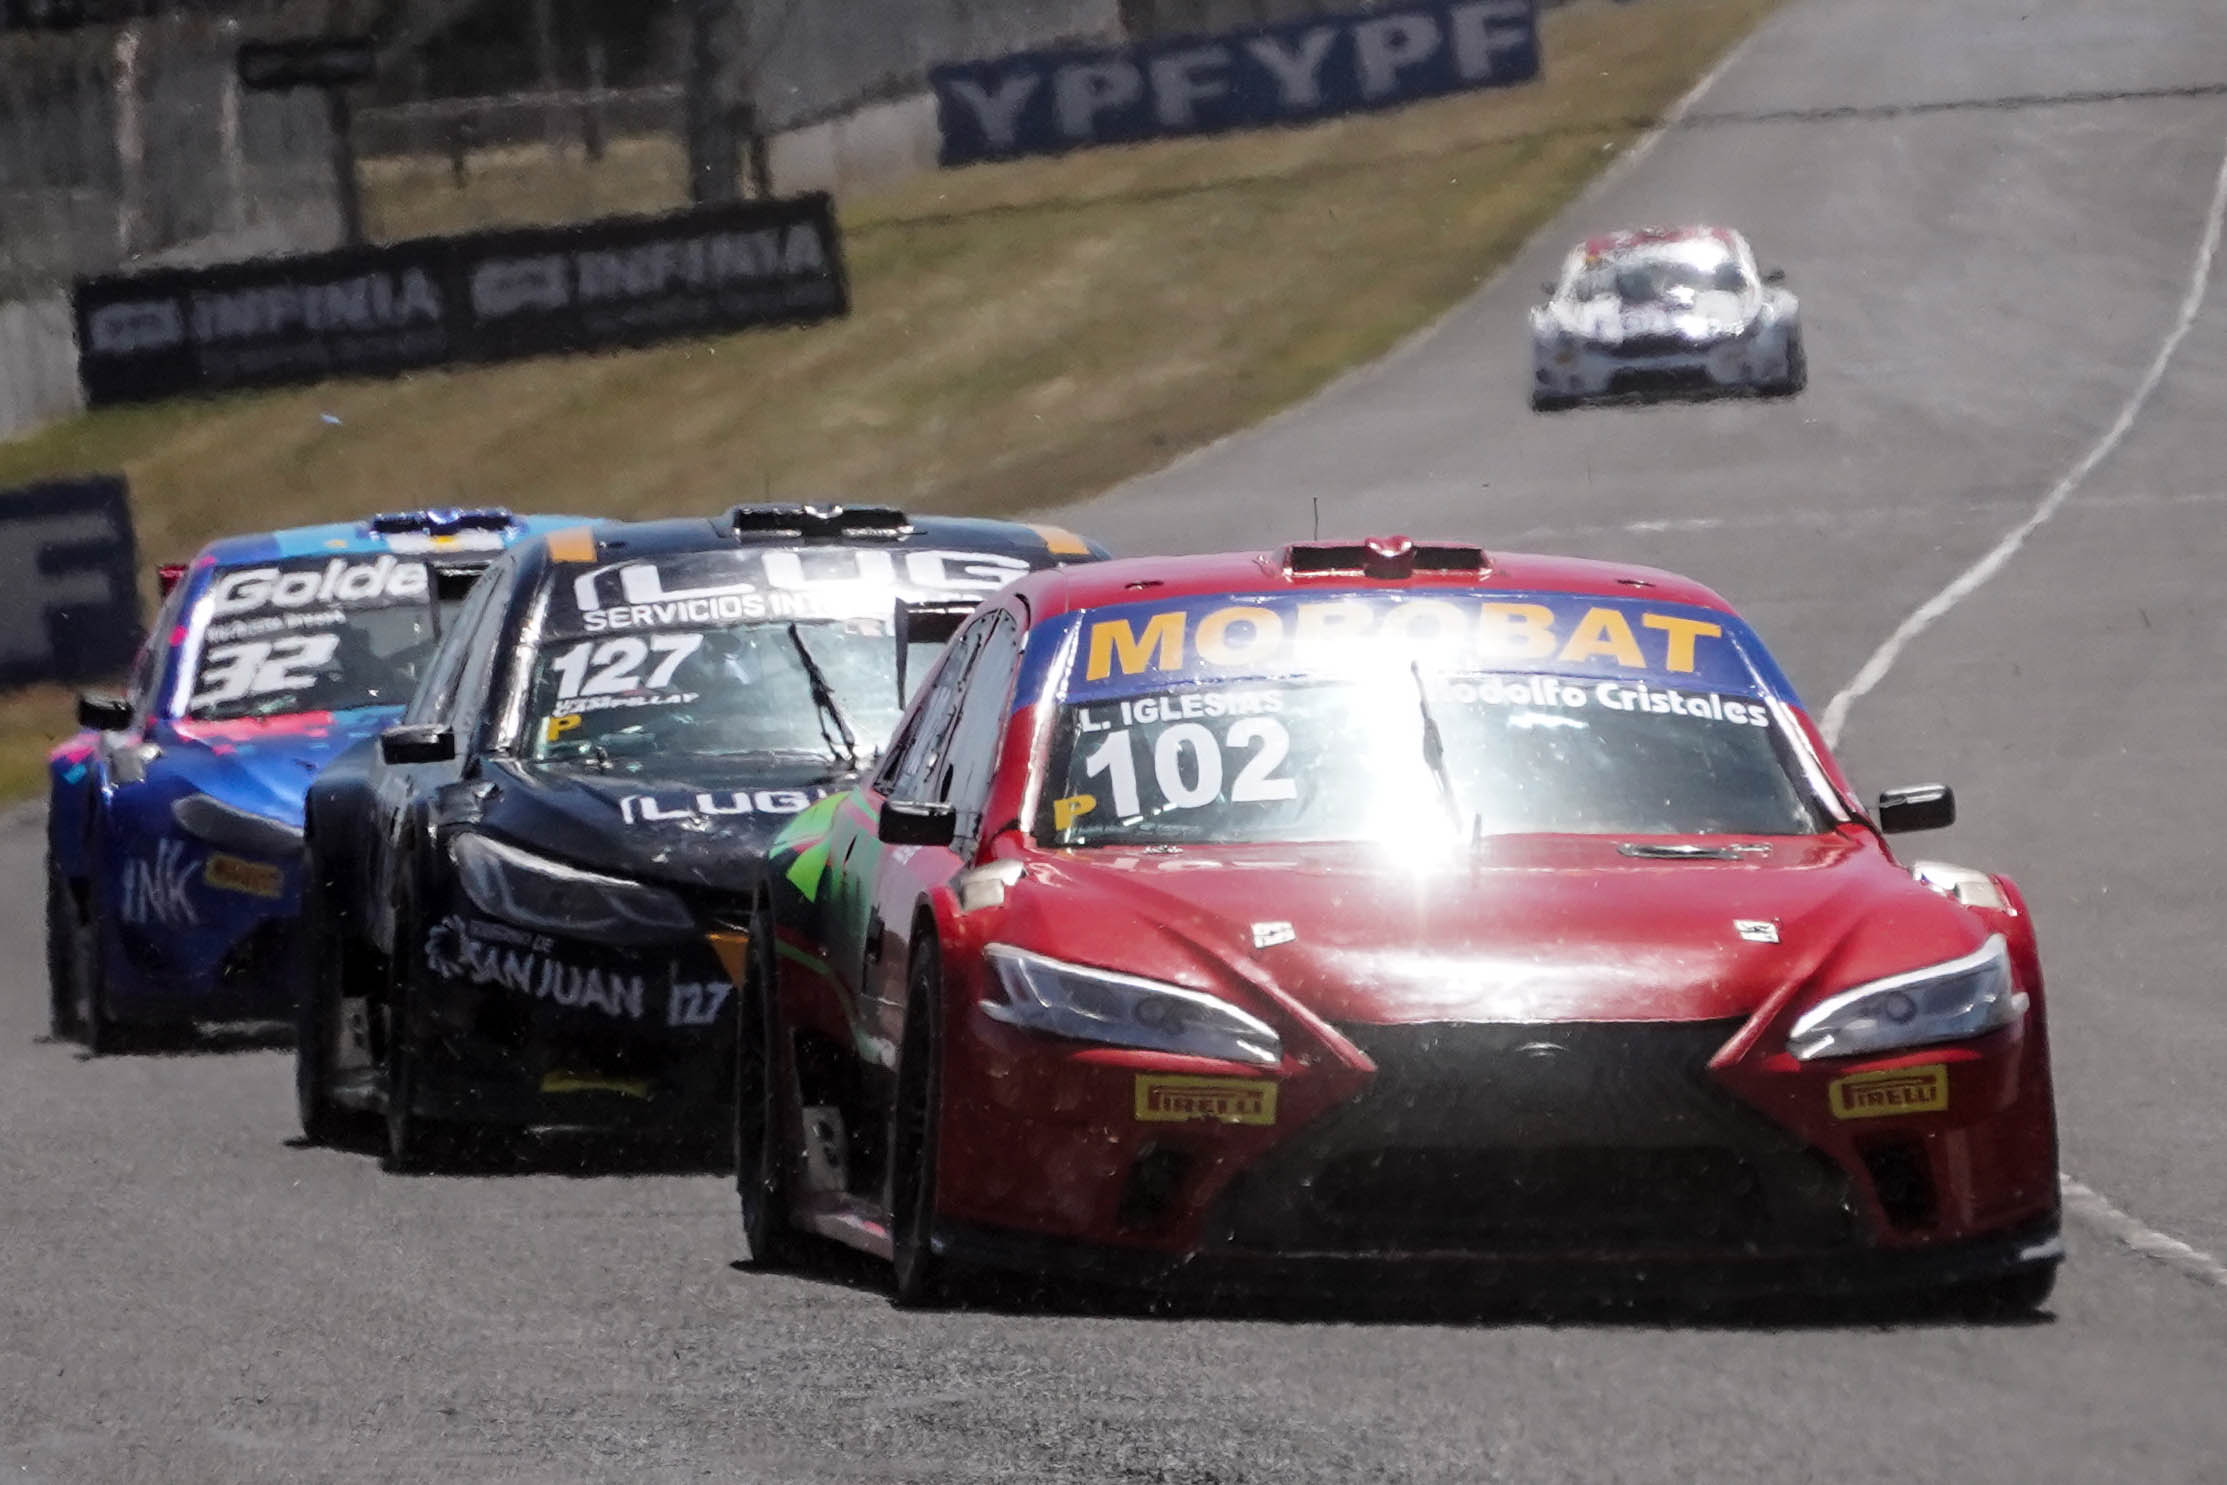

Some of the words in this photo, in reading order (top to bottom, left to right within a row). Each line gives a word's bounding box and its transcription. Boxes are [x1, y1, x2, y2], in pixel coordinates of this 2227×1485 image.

[1248, 3, 1532, 108] YPF
[951, 44, 1232, 148] YPF
[583, 594, 766, 633] SERVICIOS
[190, 633, 340, 709] 32
[553, 633, 703, 699] 127
[547, 714, 582, 741] P
[1079, 707, 1111, 733] L.
[1121, 689, 1281, 726] IGLESIAS
[1430, 675, 1587, 708] odolfo
[1596, 683, 1769, 728] Cristales
[1086, 716, 1297, 818] 102
[1054, 794, 1096, 831] P
[537, 957, 644, 1018] JUAN
[667, 962, 733, 1027] 127
[1841, 1074, 1937, 1111] PIRELLI
